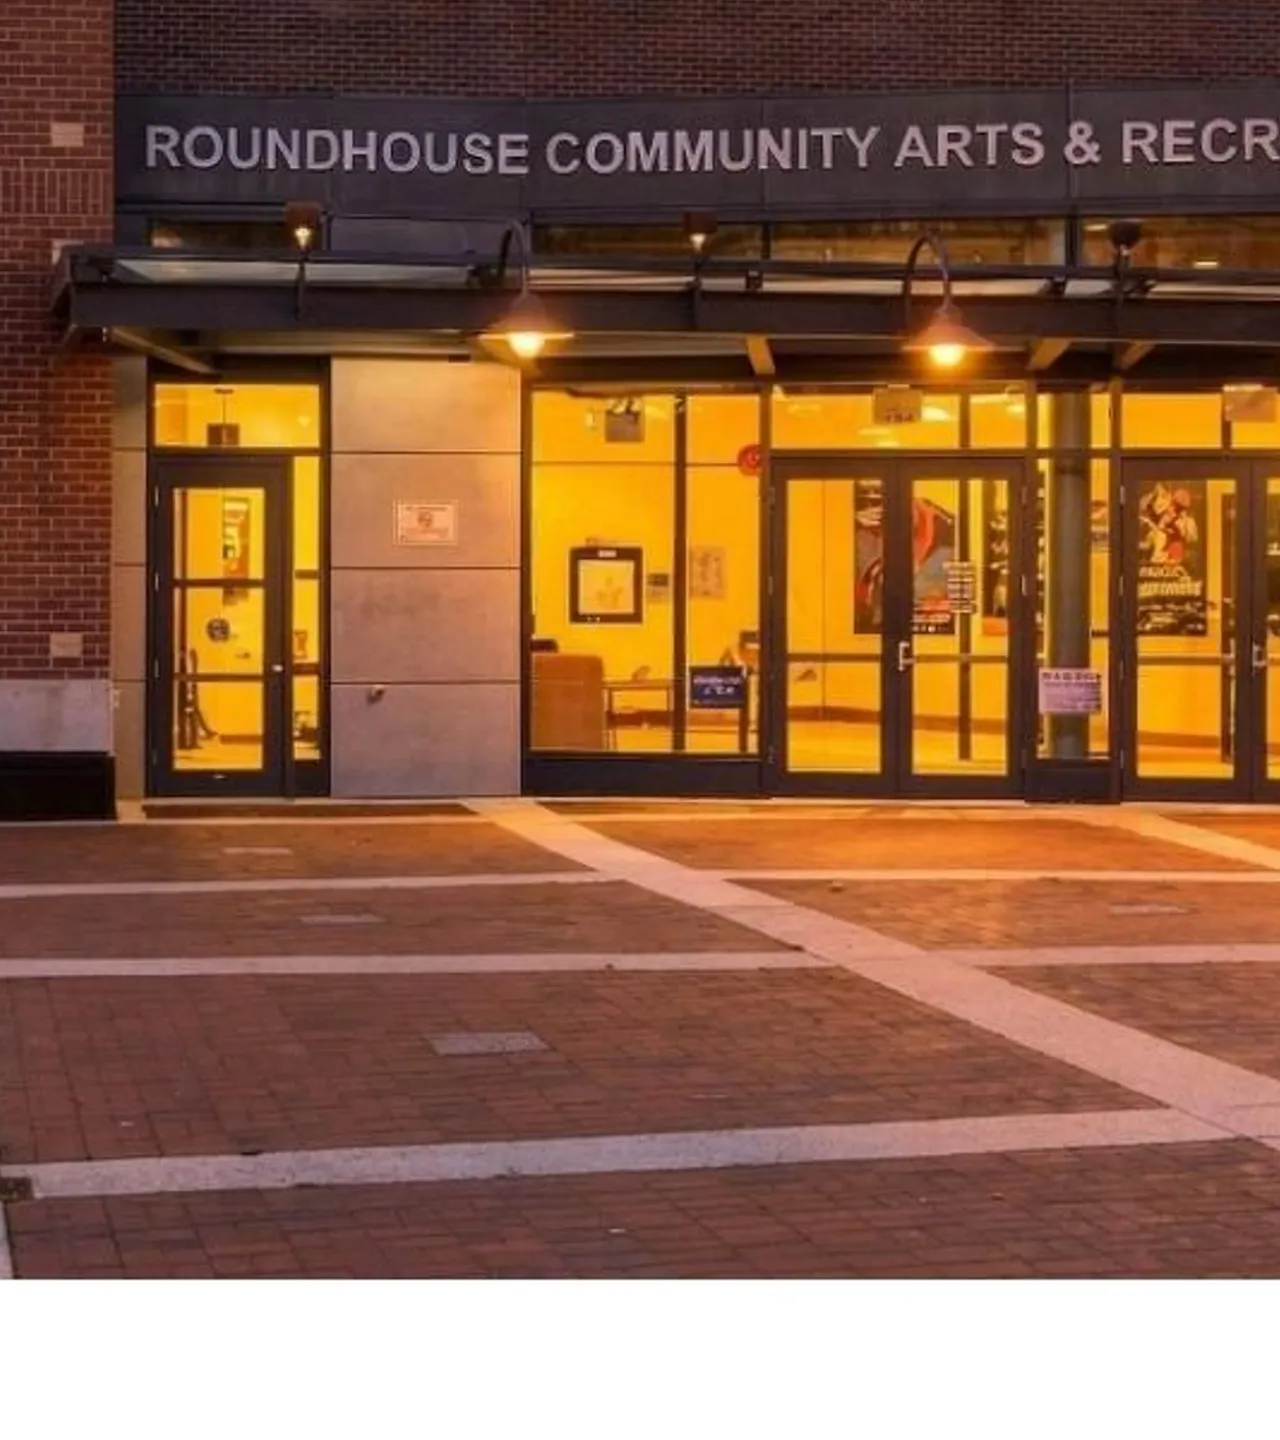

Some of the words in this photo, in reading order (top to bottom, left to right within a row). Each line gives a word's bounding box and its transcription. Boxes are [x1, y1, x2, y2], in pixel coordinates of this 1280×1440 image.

[145, 124, 530, 175] ROUNDHOUSE
[545, 125, 881, 175] COMMUNITY
[893, 121, 1046, 168] ARTS
[1062, 120, 1102, 166] &
